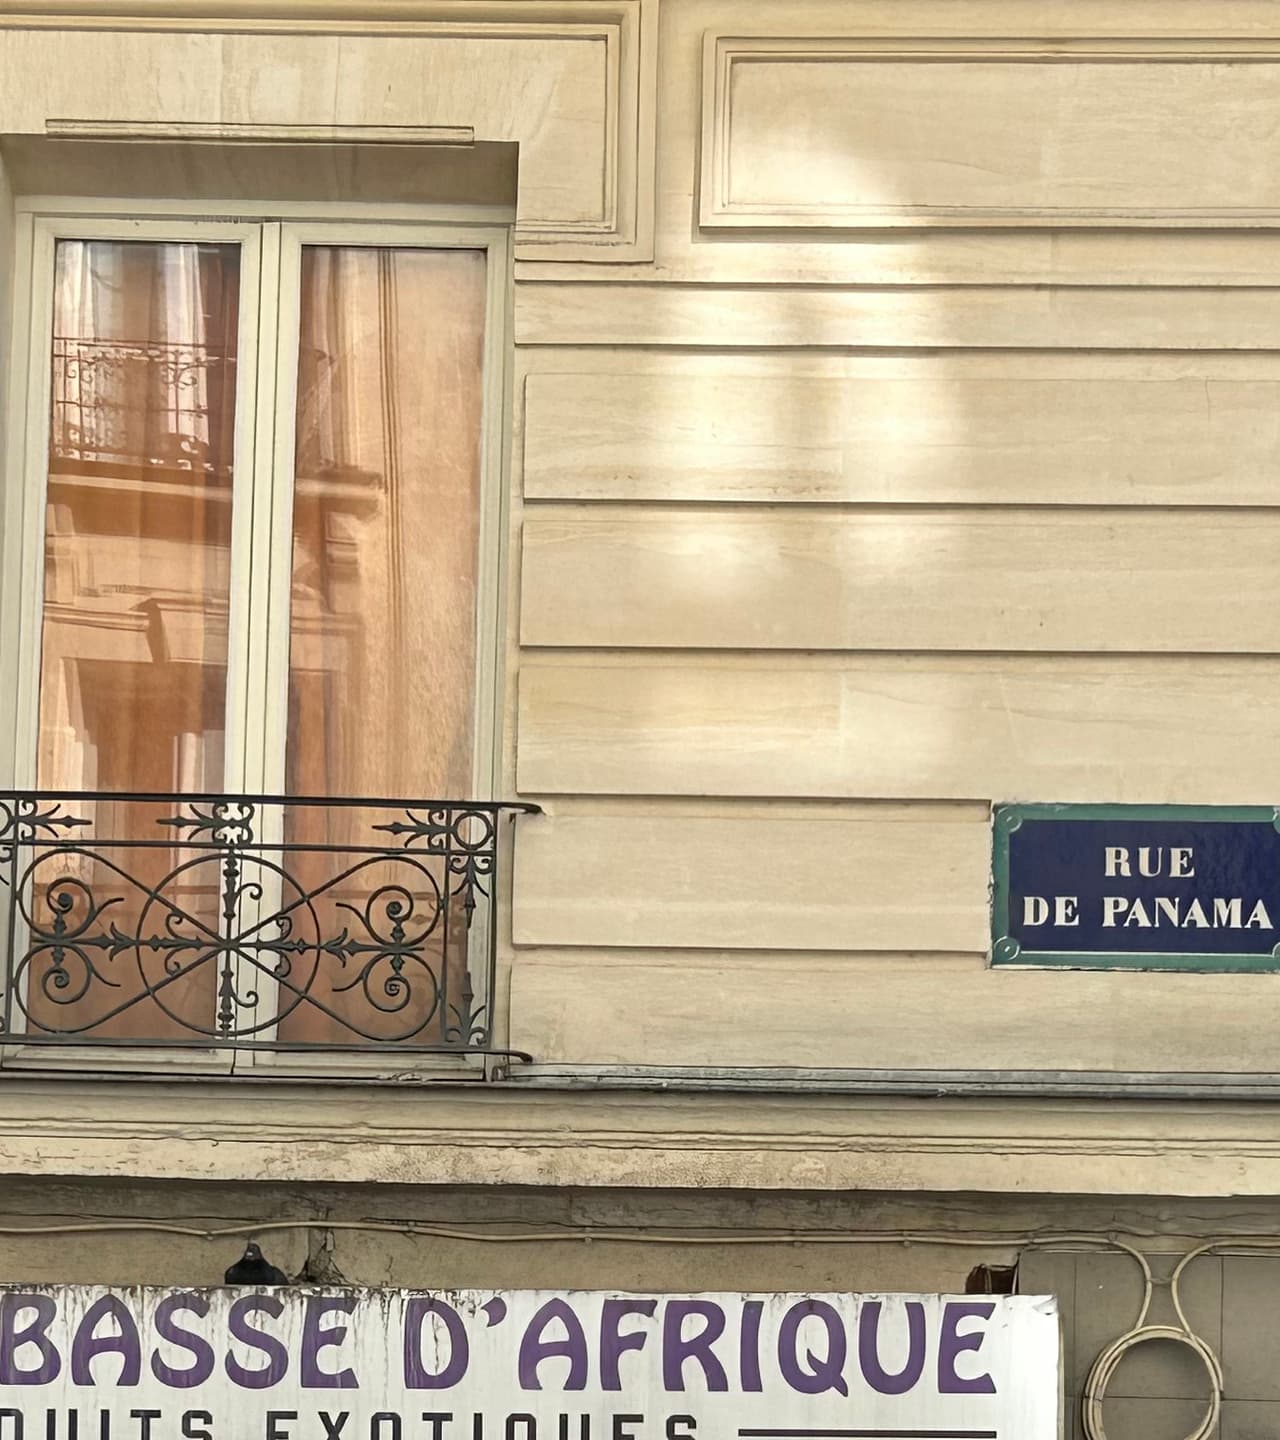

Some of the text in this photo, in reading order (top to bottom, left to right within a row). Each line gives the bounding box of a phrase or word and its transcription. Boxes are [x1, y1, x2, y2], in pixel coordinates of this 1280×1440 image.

[1105, 847, 1194, 877] RUE
[1024, 897, 1273, 929] DE PANAMA
[405, 1296, 996, 1397] D'AFRIQUE
